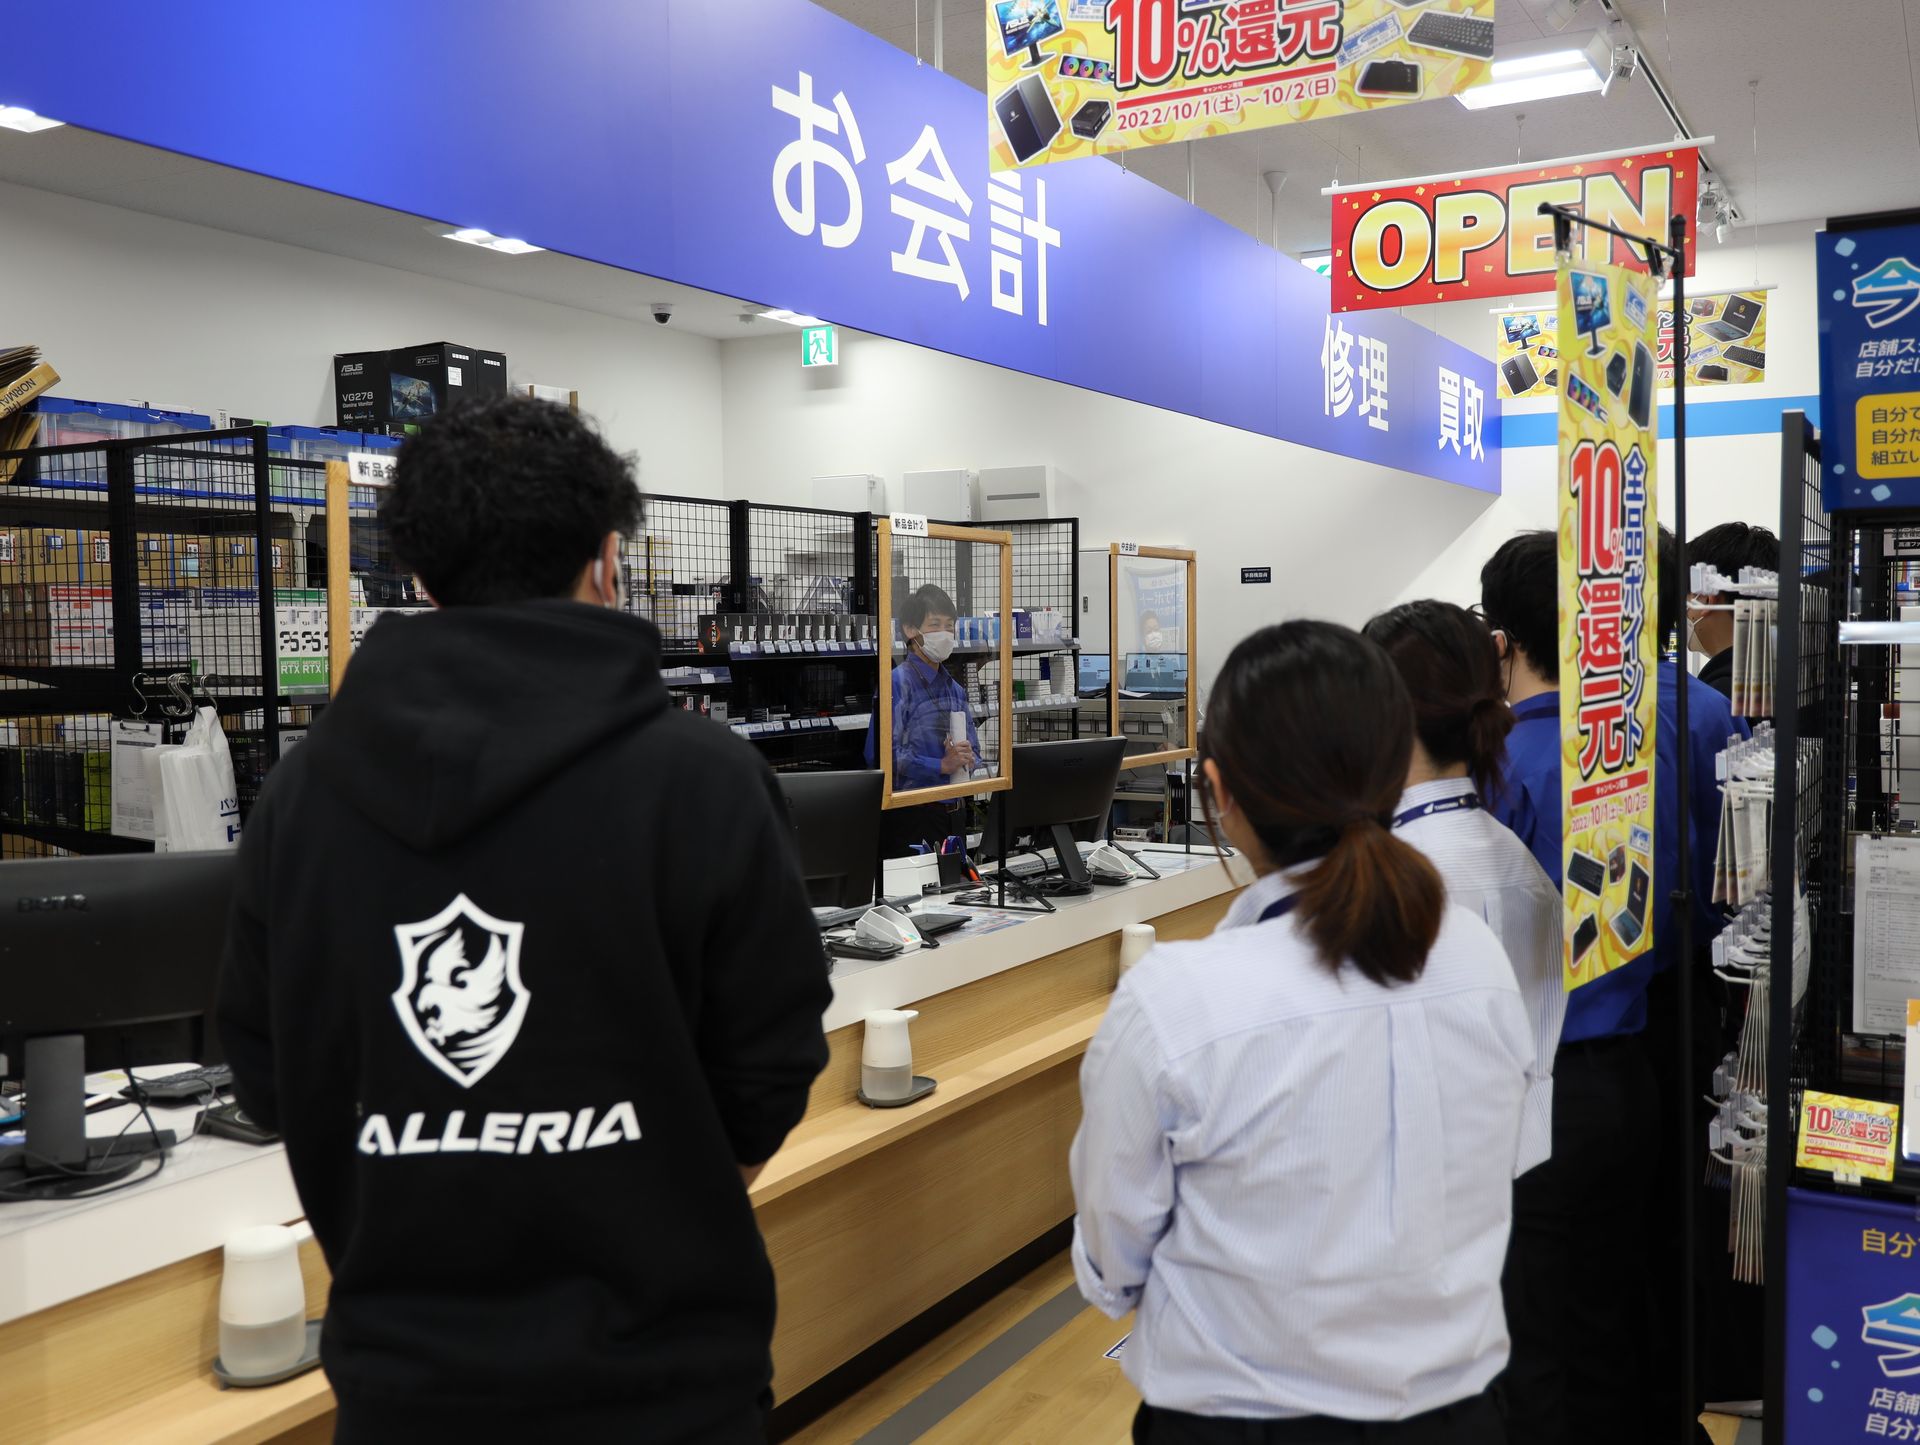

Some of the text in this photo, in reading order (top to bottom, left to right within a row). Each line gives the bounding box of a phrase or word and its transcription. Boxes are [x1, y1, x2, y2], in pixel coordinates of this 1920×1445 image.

[771, 70, 1061, 326] お会計
[1350, 164, 1674, 291] OPEN
[1858, 337, 1920, 359] 店舗ス
[341, 363, 364, 373] ASUS
[1320, 313, 1390, 433] 修理
[342, 391, 374, 402] VG278
[1437, 366, 1486, 464] 買取
[280, 665, 300, 675] RTX
[302, 665, 322, 675] RTX
[1861, 1228, 1920, 1259] 自分
[1864, 1412, 1920, 1444] 自分
